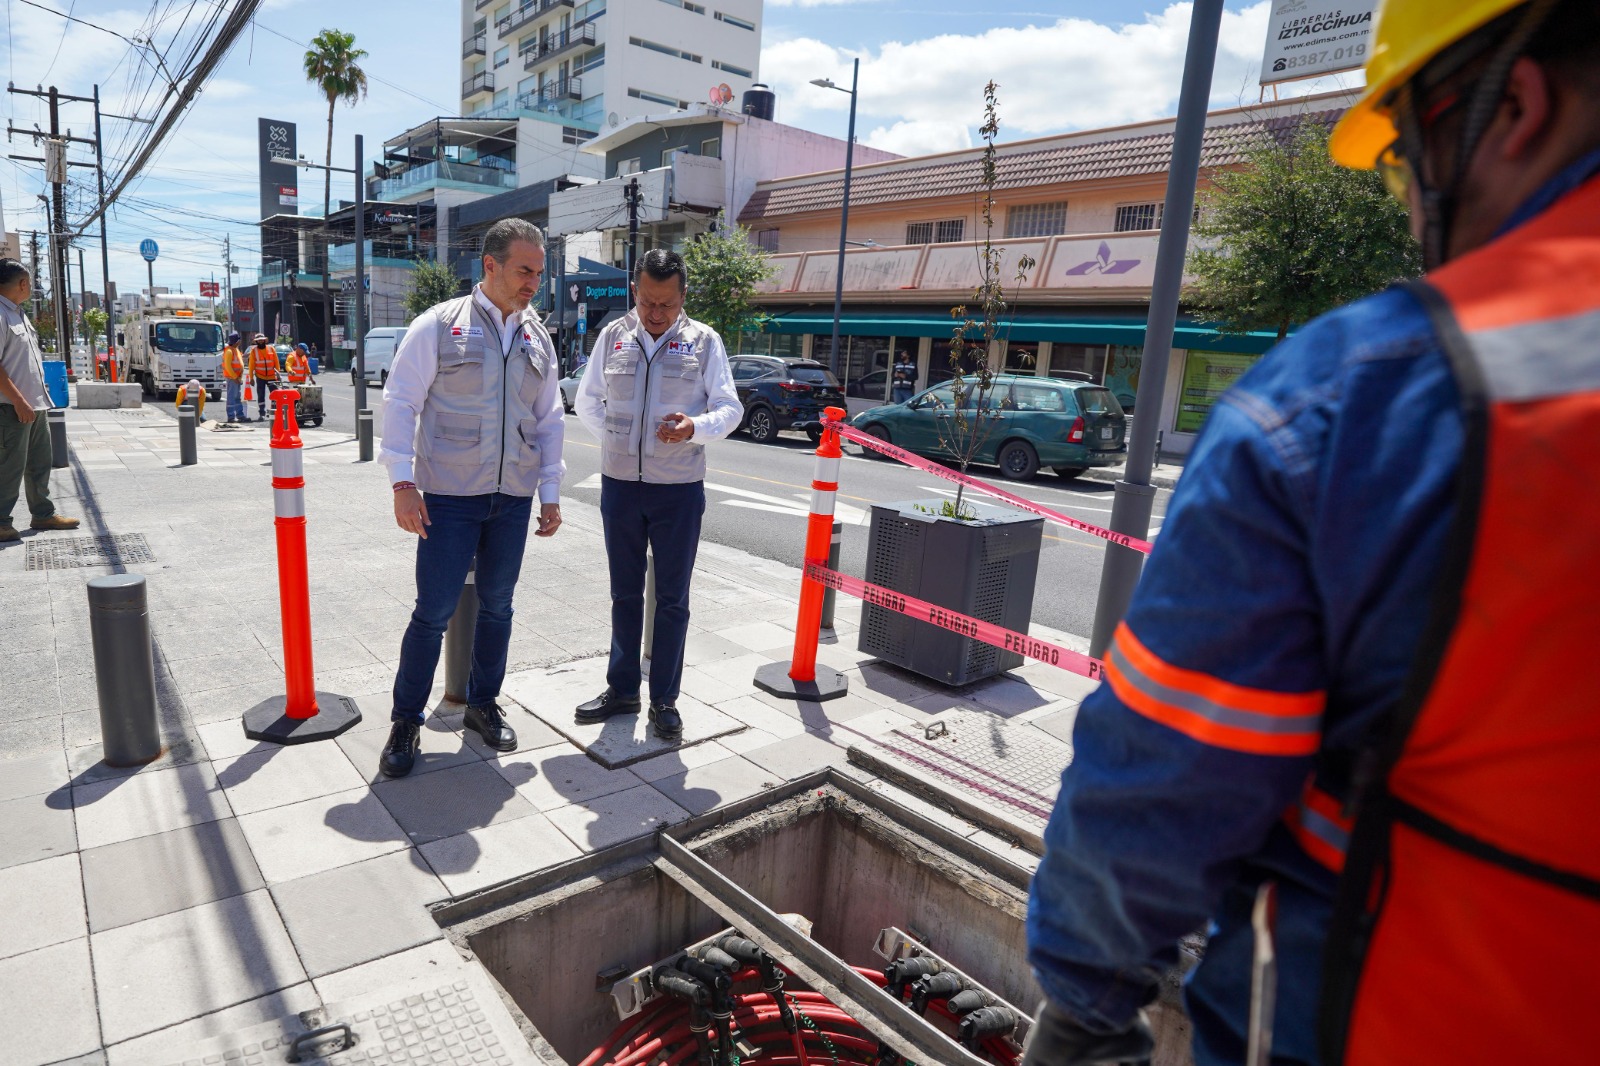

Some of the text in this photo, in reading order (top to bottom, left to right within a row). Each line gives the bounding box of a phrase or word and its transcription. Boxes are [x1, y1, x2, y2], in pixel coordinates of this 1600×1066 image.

[1278, 10, 1377, 41] IZTACCIHUA
[1282, 10, 1342, 29] LIBRERIAS
[586, 286, 608, 299] Dogtor
[669, 341, 693, 353] MTY
[805, 564, 843, 590] PELIGRO
[863, 585, 906, 613] PELIGRO
[929, 607, 978, 638] PELIGRO
[1005, 632, 1060, 666] PELIGRO
